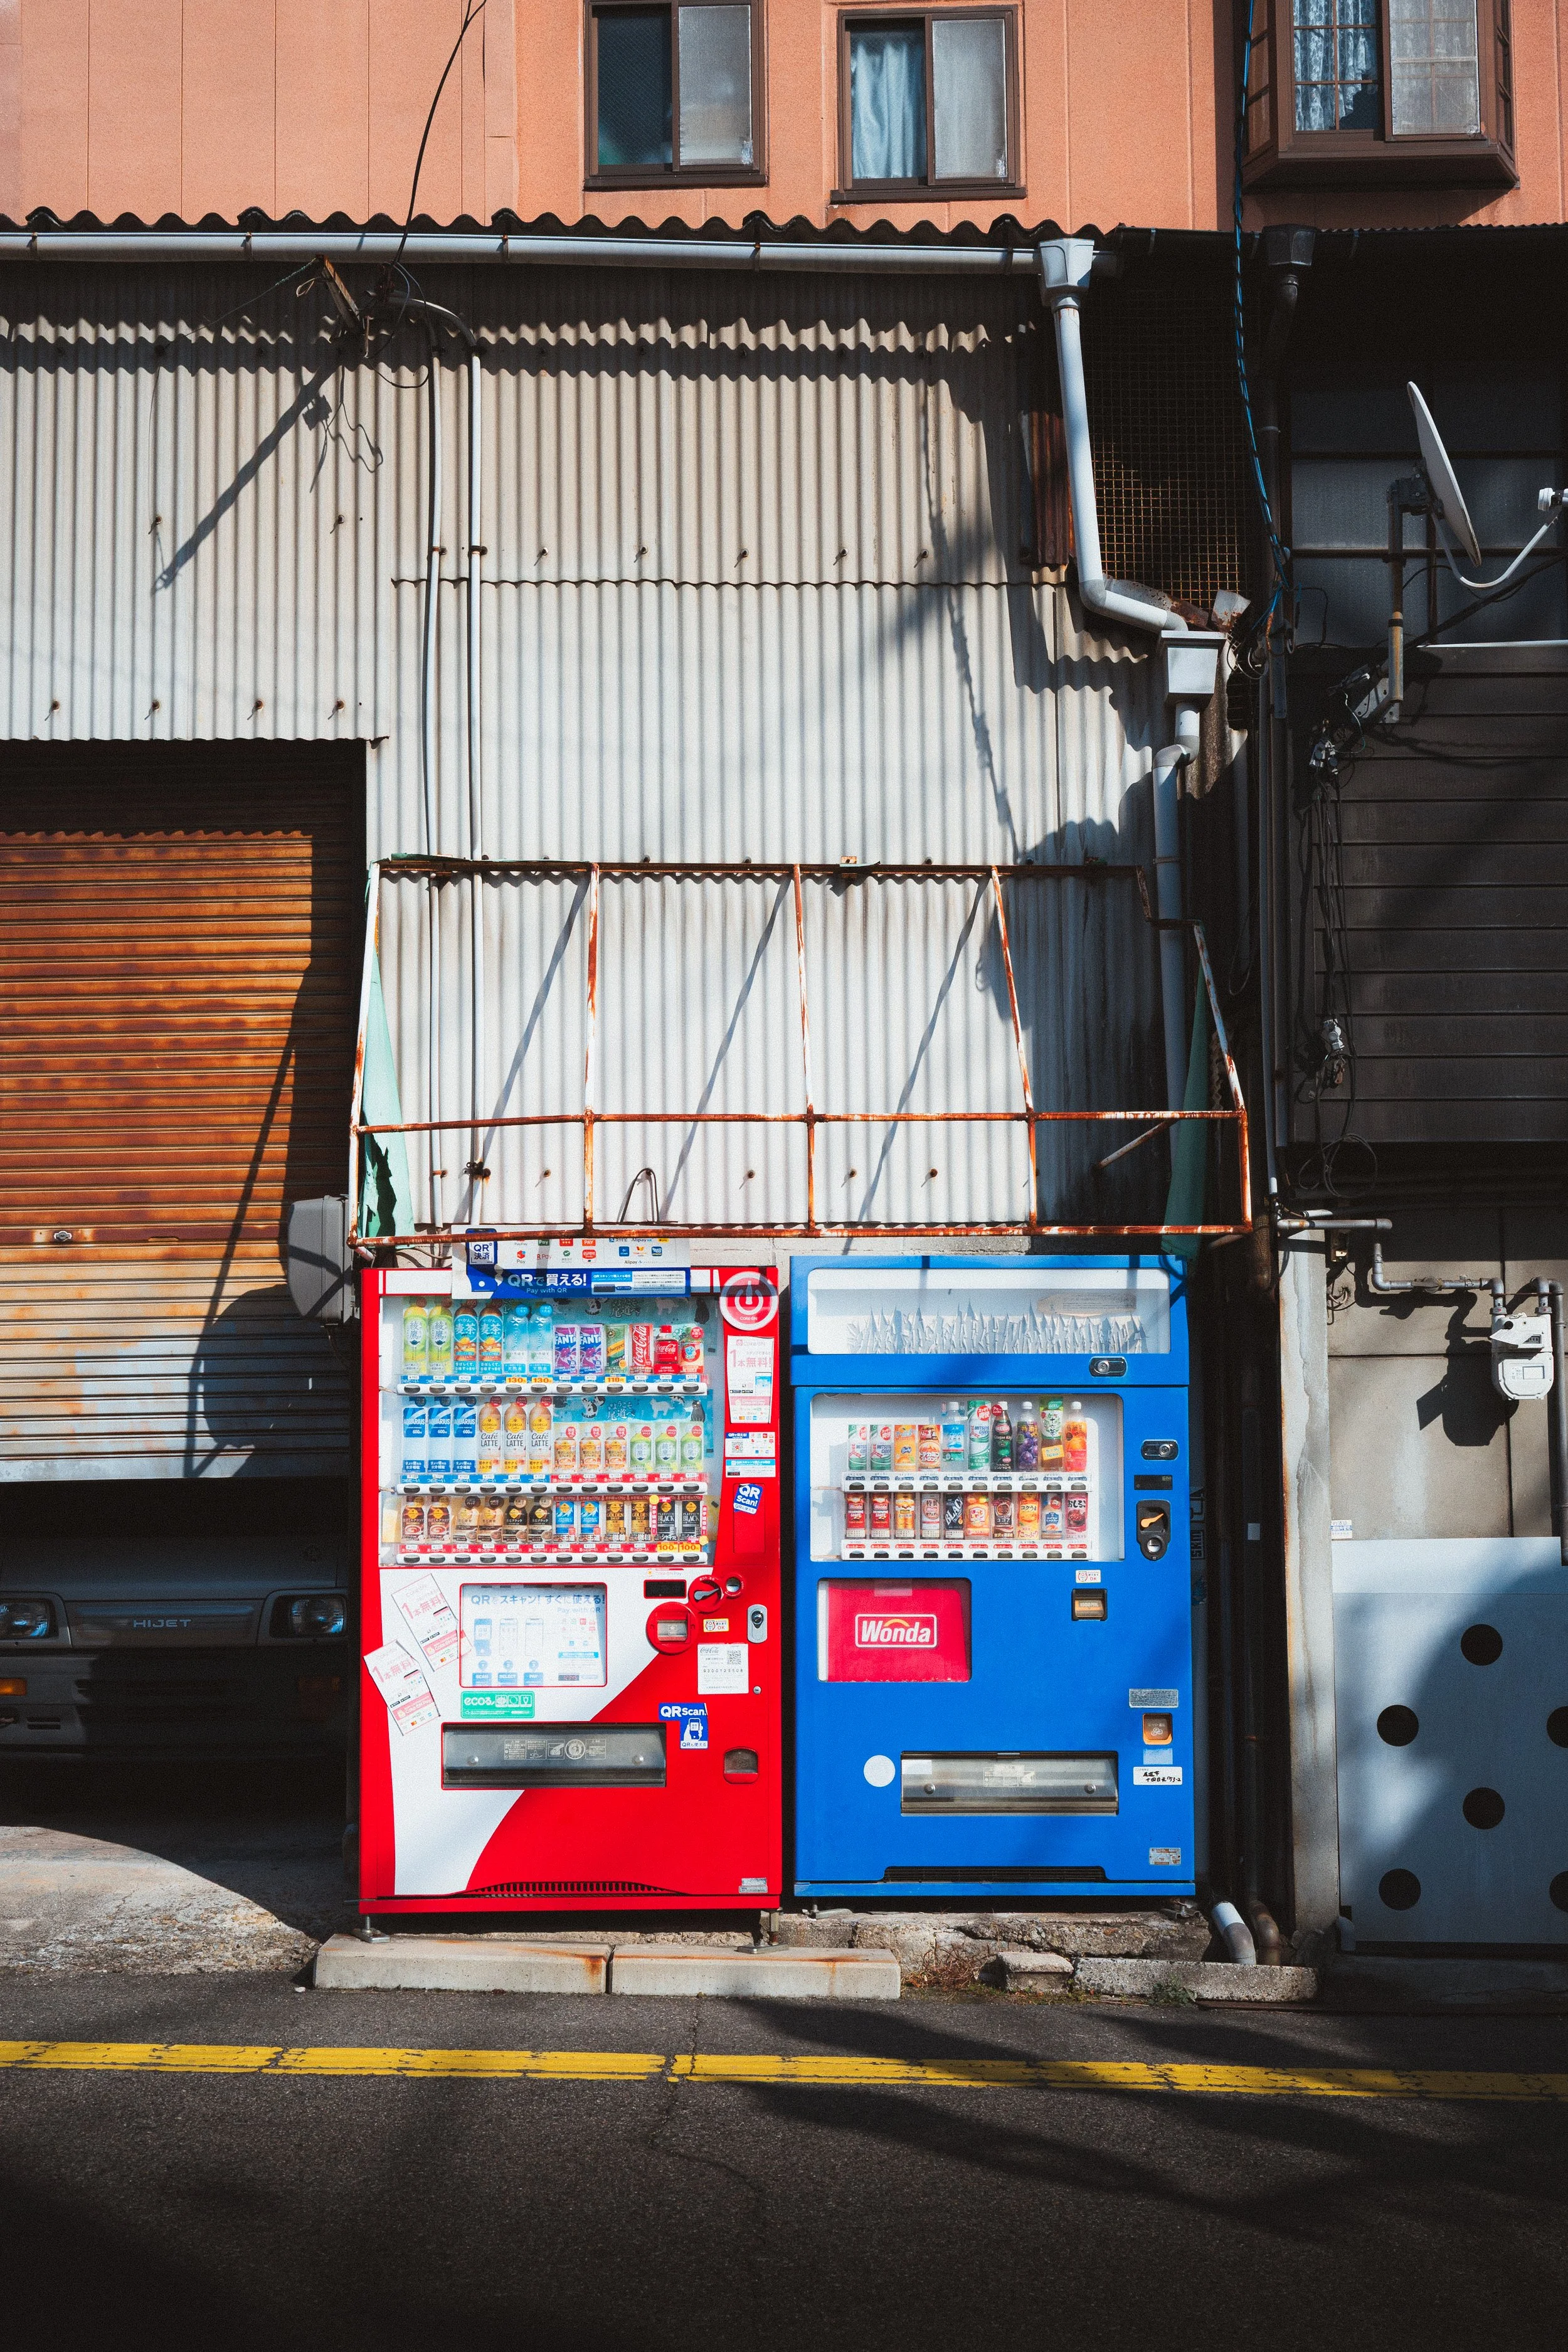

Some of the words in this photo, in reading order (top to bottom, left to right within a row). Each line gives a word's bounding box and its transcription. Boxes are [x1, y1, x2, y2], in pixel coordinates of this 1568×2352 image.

[474, 1252, 490, 1260] 決済
[455, 1323, 476, 1335] 麦茶
[480, 1323, 501, 1335] 麦茶
[608, 1408, 635, 1422] 尾道へ
[739, 1485, 761, 1500] QR
[736, 1495, 758, 1507] Scan!
[133, 1619, 191, 1628] HIJET
[861, 1620, 931, 1643] Wonda
[660, 1705, 682, 1718] QR
